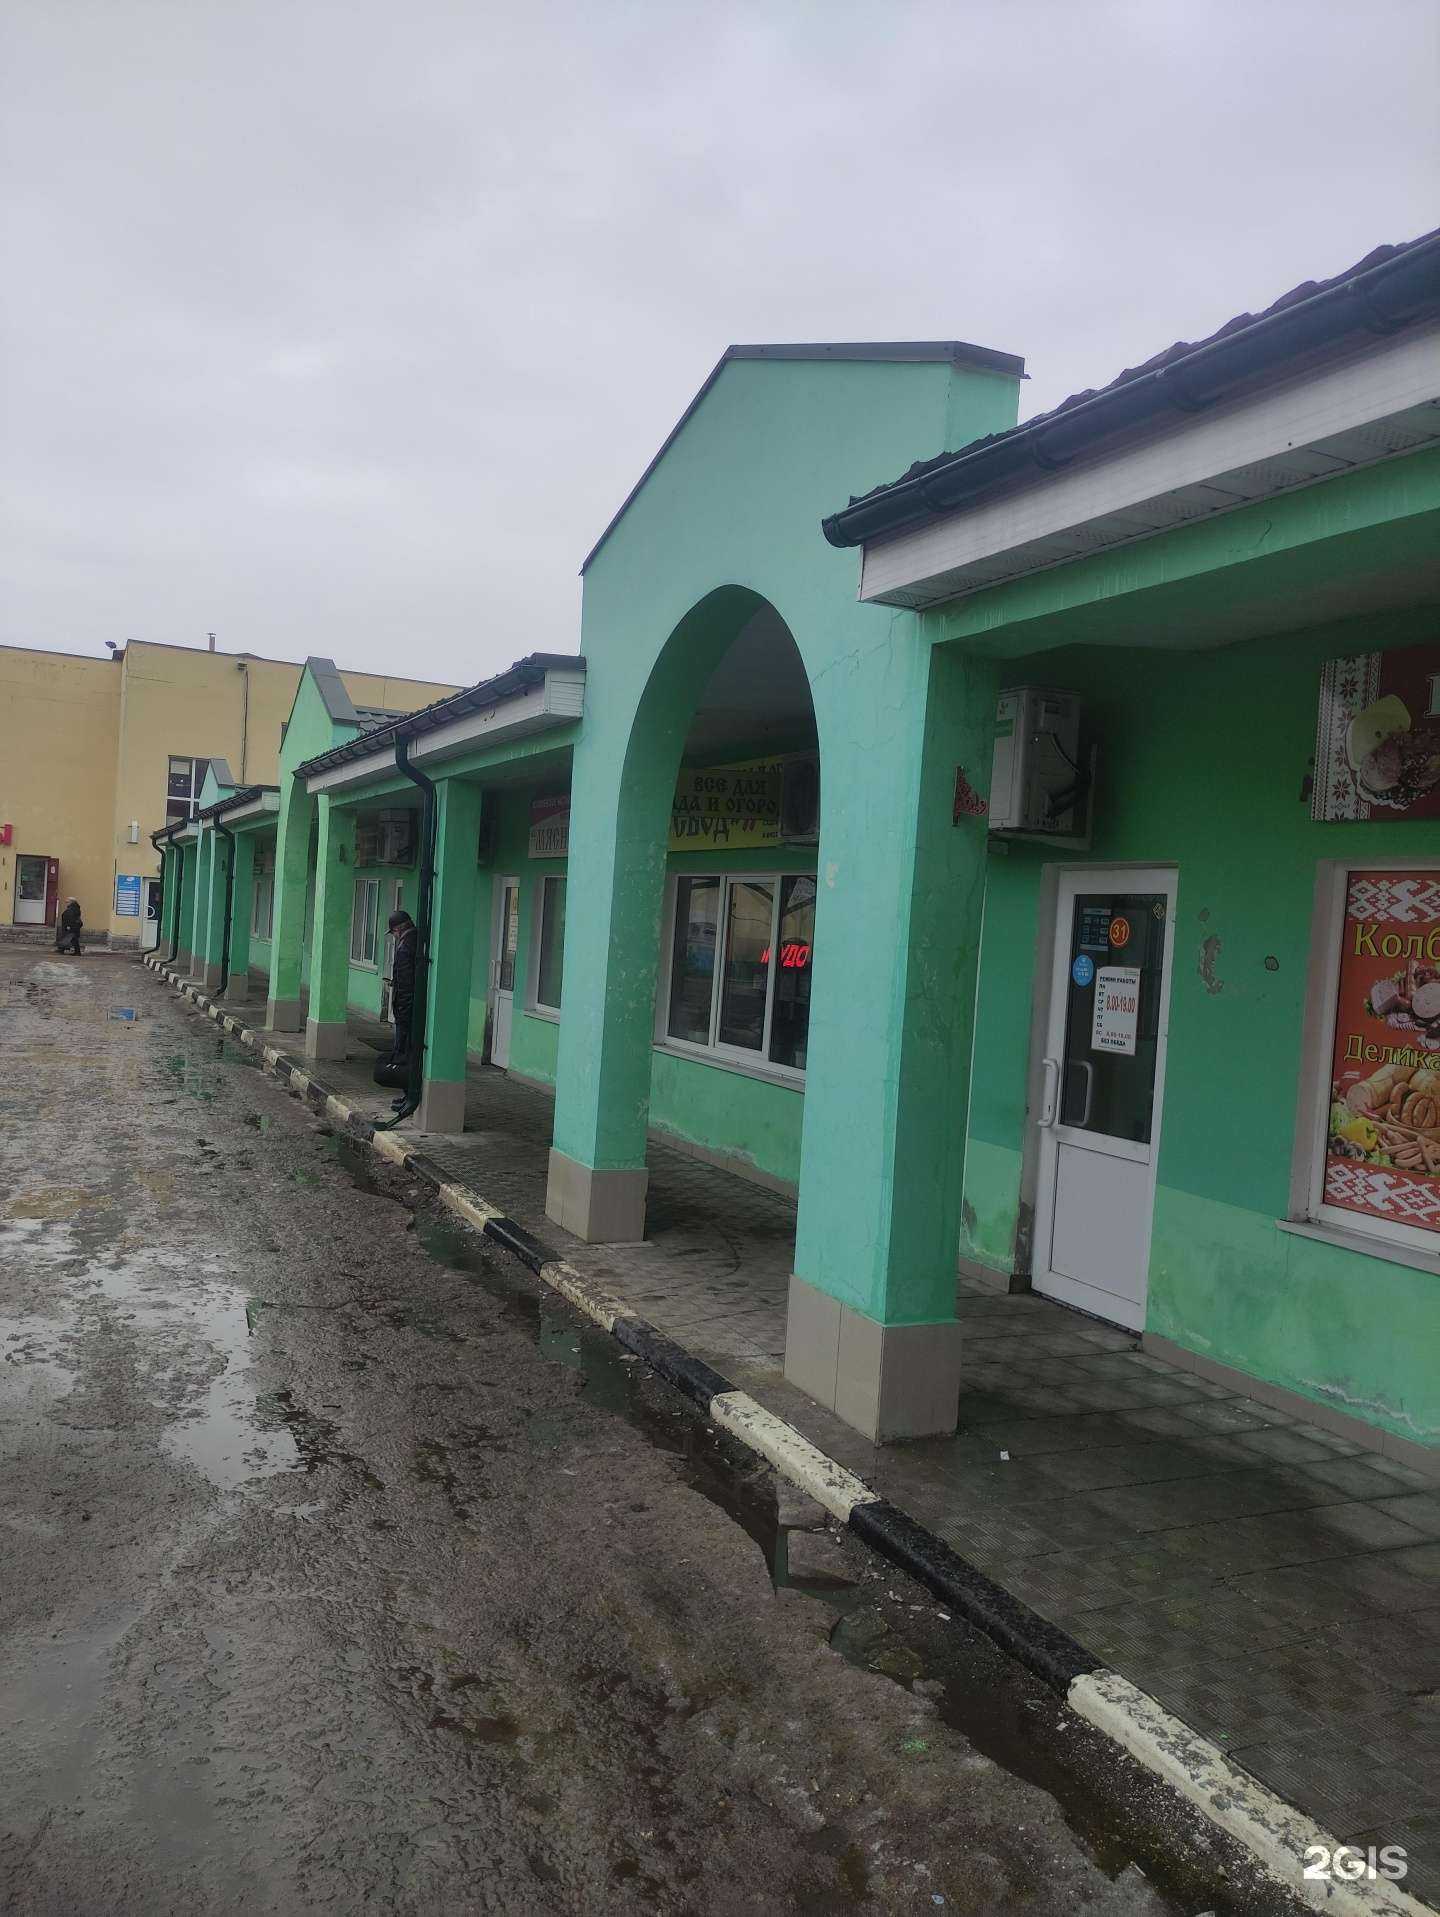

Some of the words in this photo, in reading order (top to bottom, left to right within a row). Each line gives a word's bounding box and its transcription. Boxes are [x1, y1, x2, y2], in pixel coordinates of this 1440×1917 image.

[726, 798, 780, 817] ОГОРО
[1112, 924, 1126, 939] 31
[1354, 922, 1440, 961] Колб
